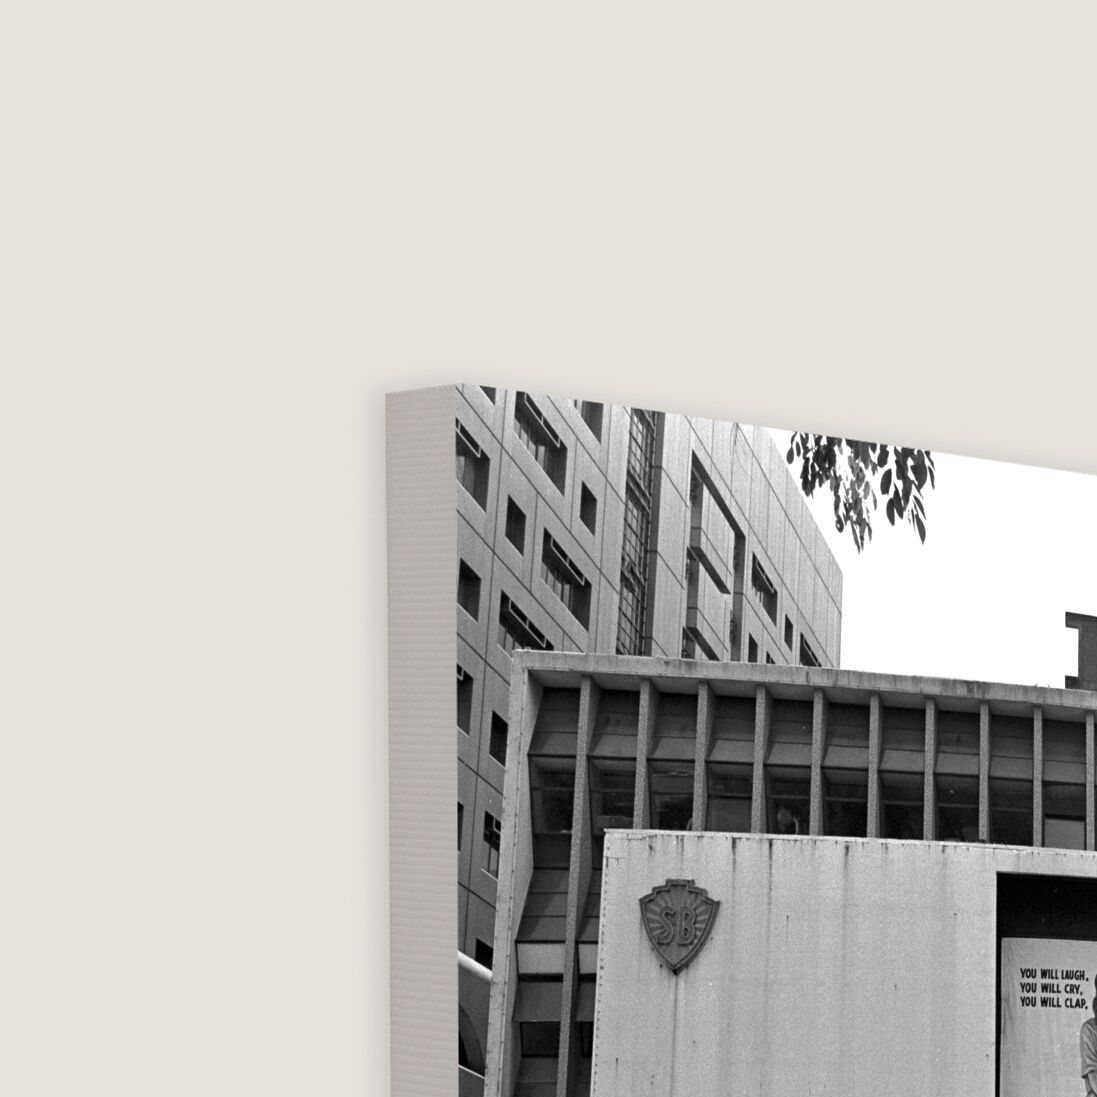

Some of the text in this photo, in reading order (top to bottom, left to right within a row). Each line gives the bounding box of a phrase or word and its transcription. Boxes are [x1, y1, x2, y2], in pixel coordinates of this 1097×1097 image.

[658, 905, 698, 945] SB
[1020, 967, 1037, 979] YOU
[1040, 968, 1059, 980] WILL
[1019, 982, 1037, 993] YOU
[1040, 983, 1062, 994] WILL
[1019, 996, 1037, 1008] YOU
[1040, 997, 1062, 1008] WILL
